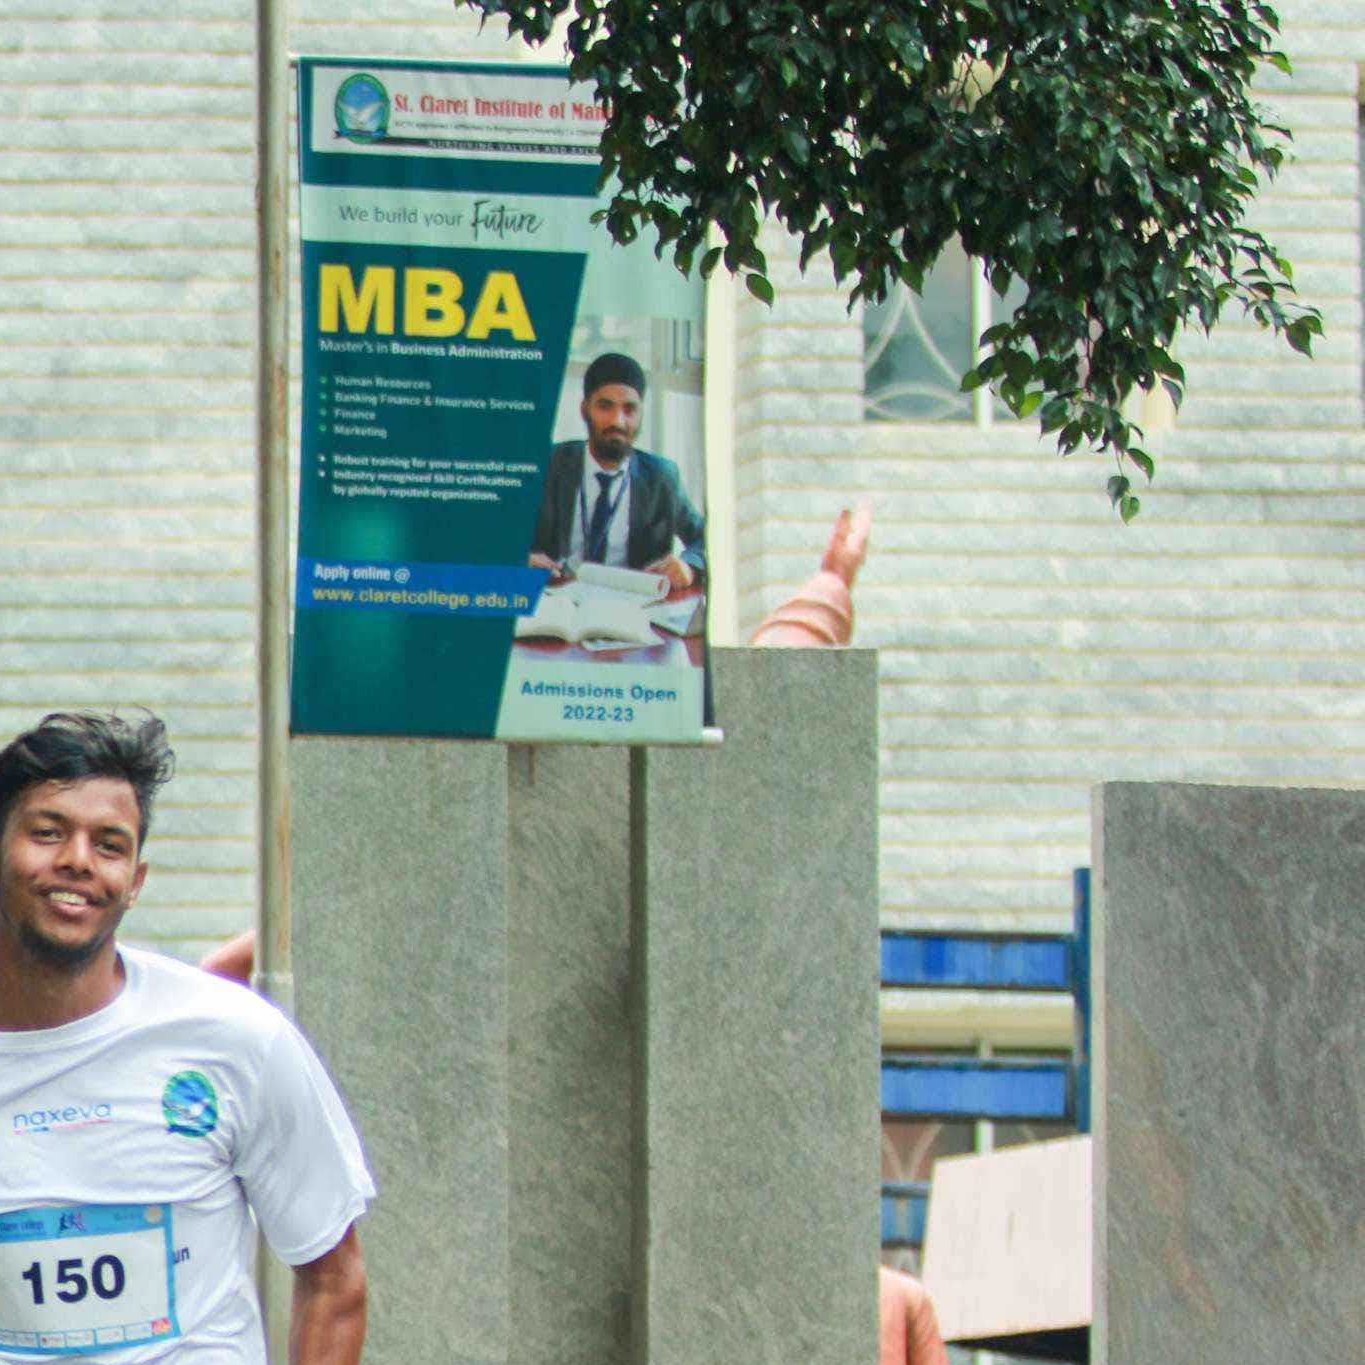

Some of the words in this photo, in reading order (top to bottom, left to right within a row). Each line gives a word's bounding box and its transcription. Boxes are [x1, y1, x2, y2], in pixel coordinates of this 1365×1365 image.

[420, 95, 468, 116] Claret
[474, 97, 543, 118] Institute
[549, 102, 566, 119] of
[339, 205, 369, 223] We
[373, 206, 418, 225] build
[423, 211, 462, 228] your
[470, 200, 544, 242] Future
[318, 264, 537, 342] MBA
[320, 340, 374, 354] Master's
[377, 342, 388, 354] in
[391, 343, 445, 357] Business
[449, 345, 543, 361] Administration
[334, 376, 373, 387] Human
[375, 378, 431, 390] Resources
[334, 392, 378, 405] Banking
[380, 394, 421, 406] Finance
[435, 397, 486, 410] Insurance
[490, 399, 535, 411] Services
[334, 409, 376, 421] Finance
[334, 425, 387, 439] Marketing
[334, 455, 369, 466] Robust
[371, 456, 410, 470] training
[412, 457, 426, 468] for
[429, 460, 452, 471] your
[454, 460, 505, 472] successful
[334, 470, 376, 482] Industry
[378, 471, 432, 484] recognised
[433, 473, 455, 484] Skill
[457, 475, 522, 487] Certifications
[334, 484, 346, 496] by
[347, 485, 387, 499] globally
[390, 487, 429, 499] reputed
[314, 563, 349, 582] Apply
[353, 565, 390, 581] online
[394, 567, 411, 584] @
[313, 586, 529, 609] www.claretcollege.edu.in
[521, 679, 624, 701] Admissions
[630, 684, 677, 703] Open
[563, 704, 635, 723] 2022-23
[13, 1103, 112, 1128] naxeva
[21, 1254, 126, 1306] 150
